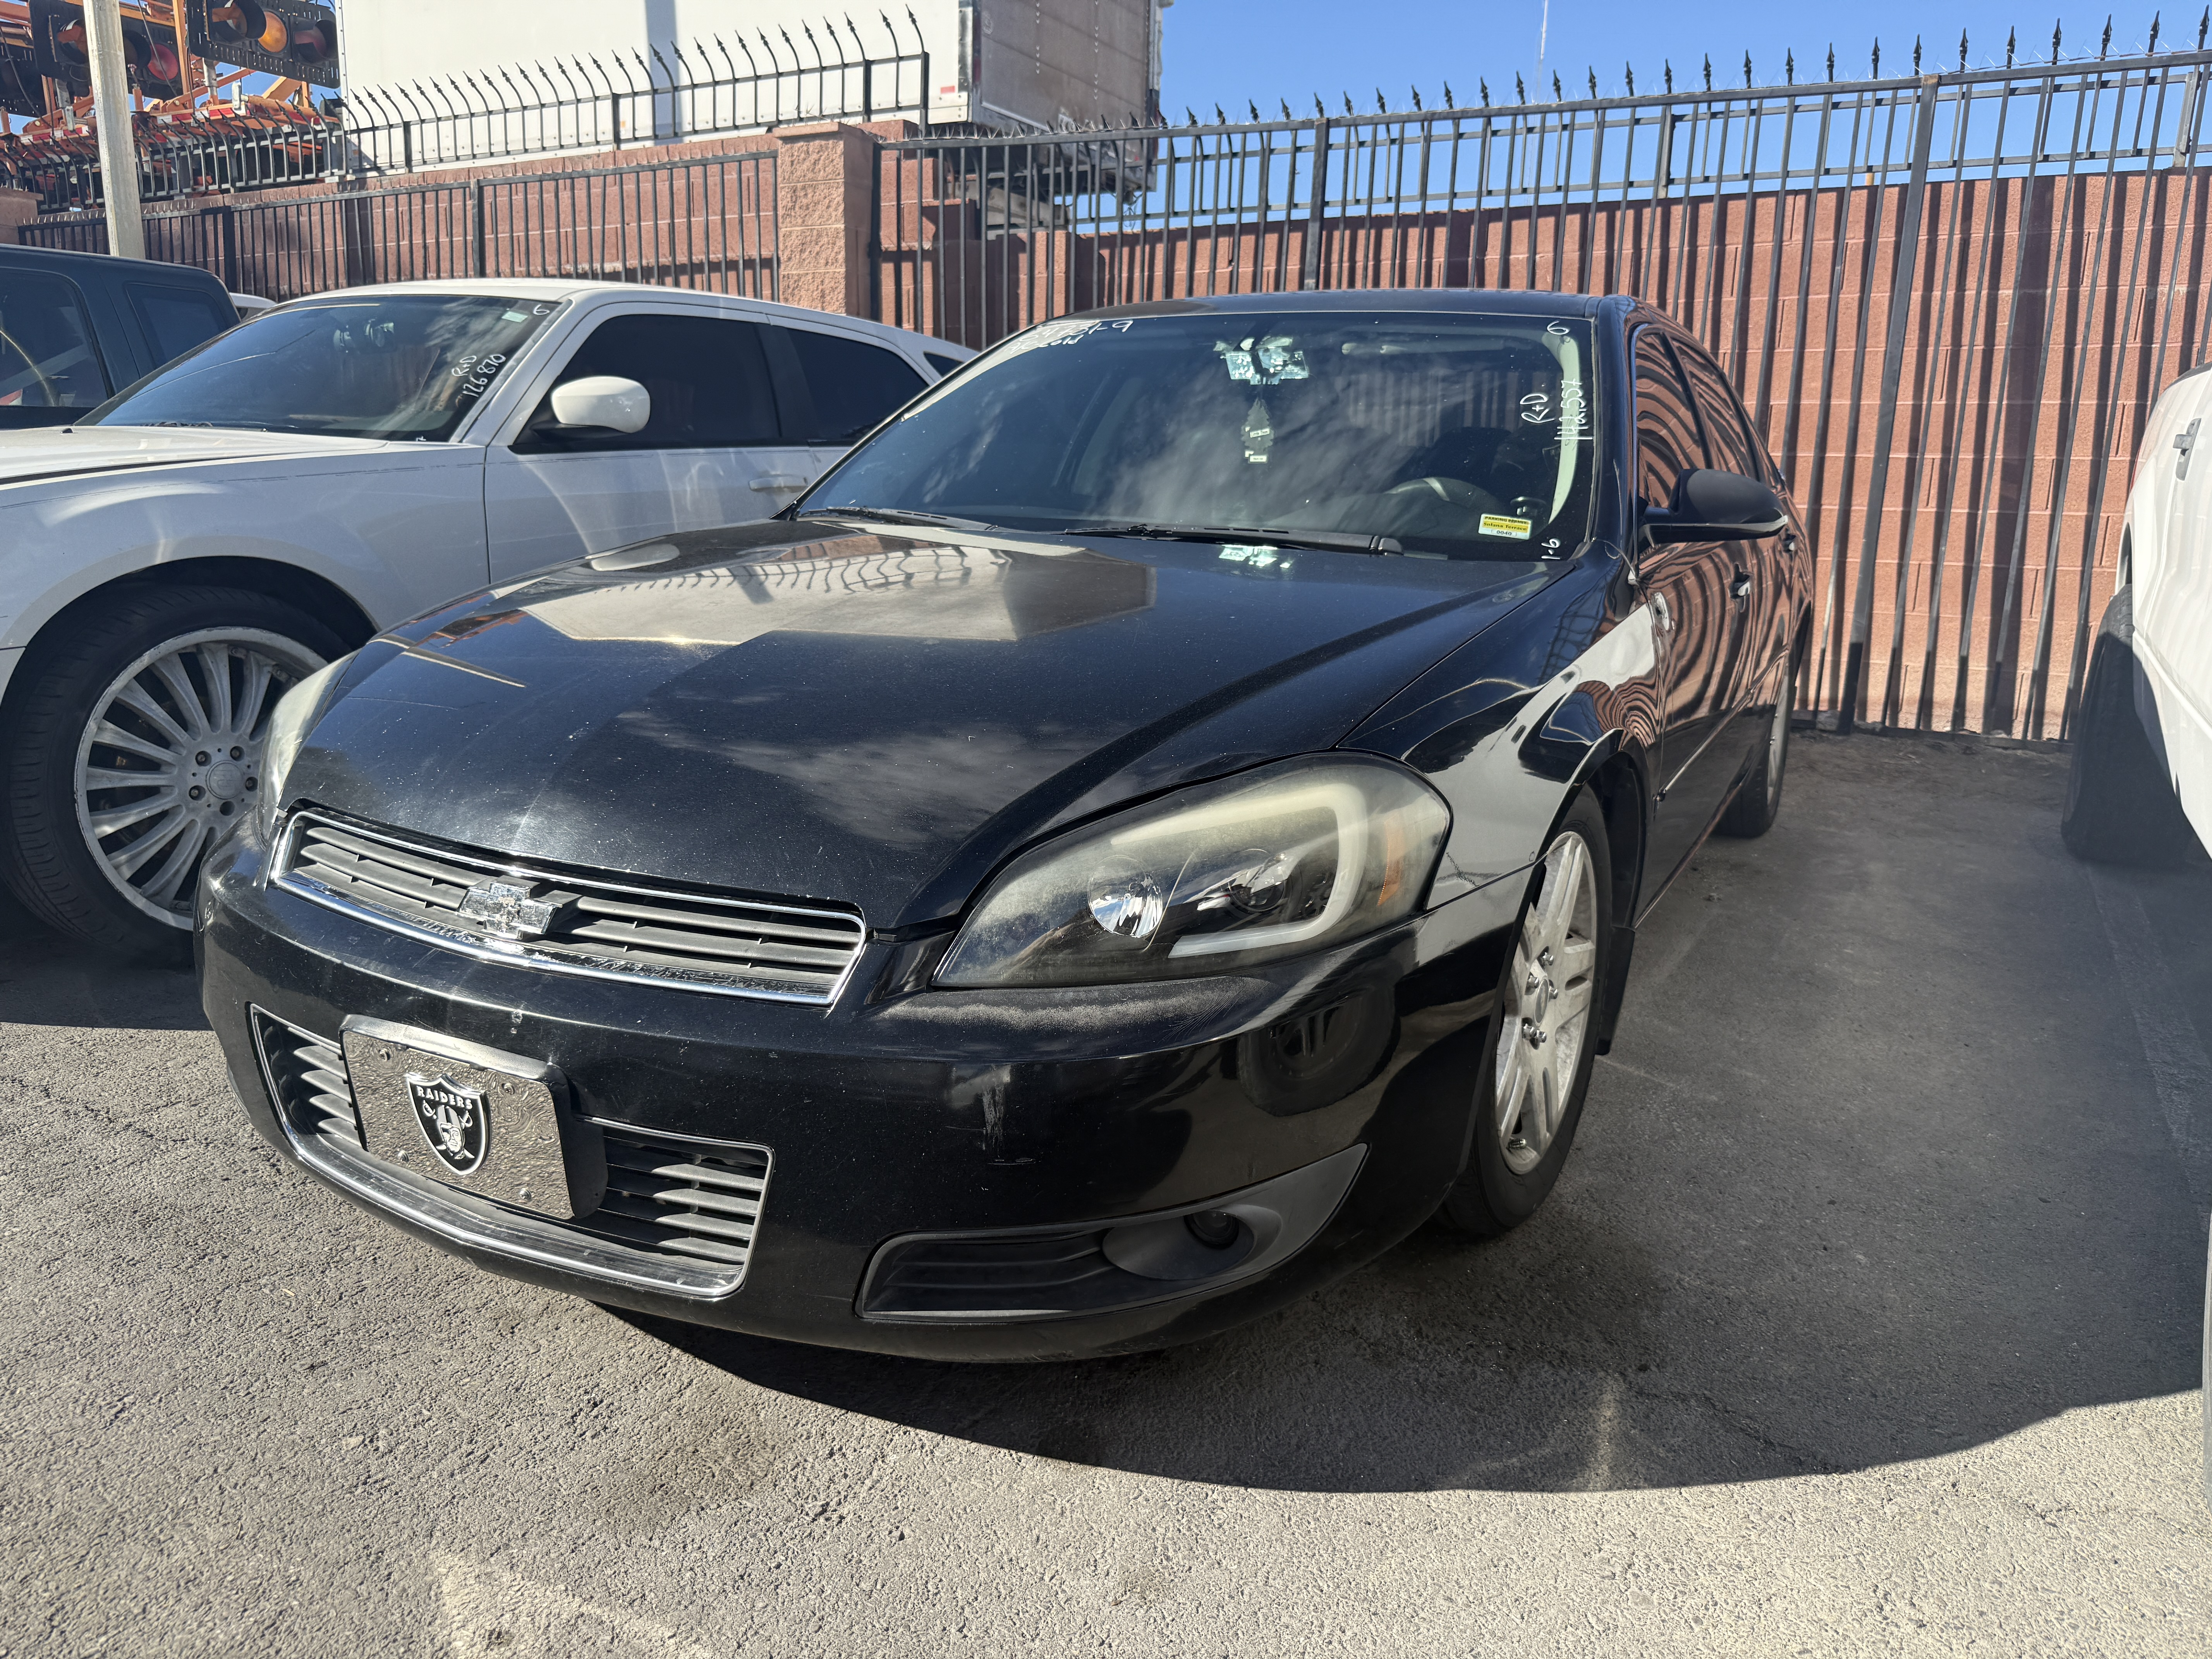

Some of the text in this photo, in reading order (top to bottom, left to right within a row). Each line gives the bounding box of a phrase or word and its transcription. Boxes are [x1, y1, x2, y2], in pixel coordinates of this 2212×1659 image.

[533, 304, 550, 315] 6
[1547, 321, 1569, 335] 6
[452, 355, 477, 376] R+D
[1520, 393, 1556, 423] R+D
[416, 1085, 473, 1110] RAIDERS
